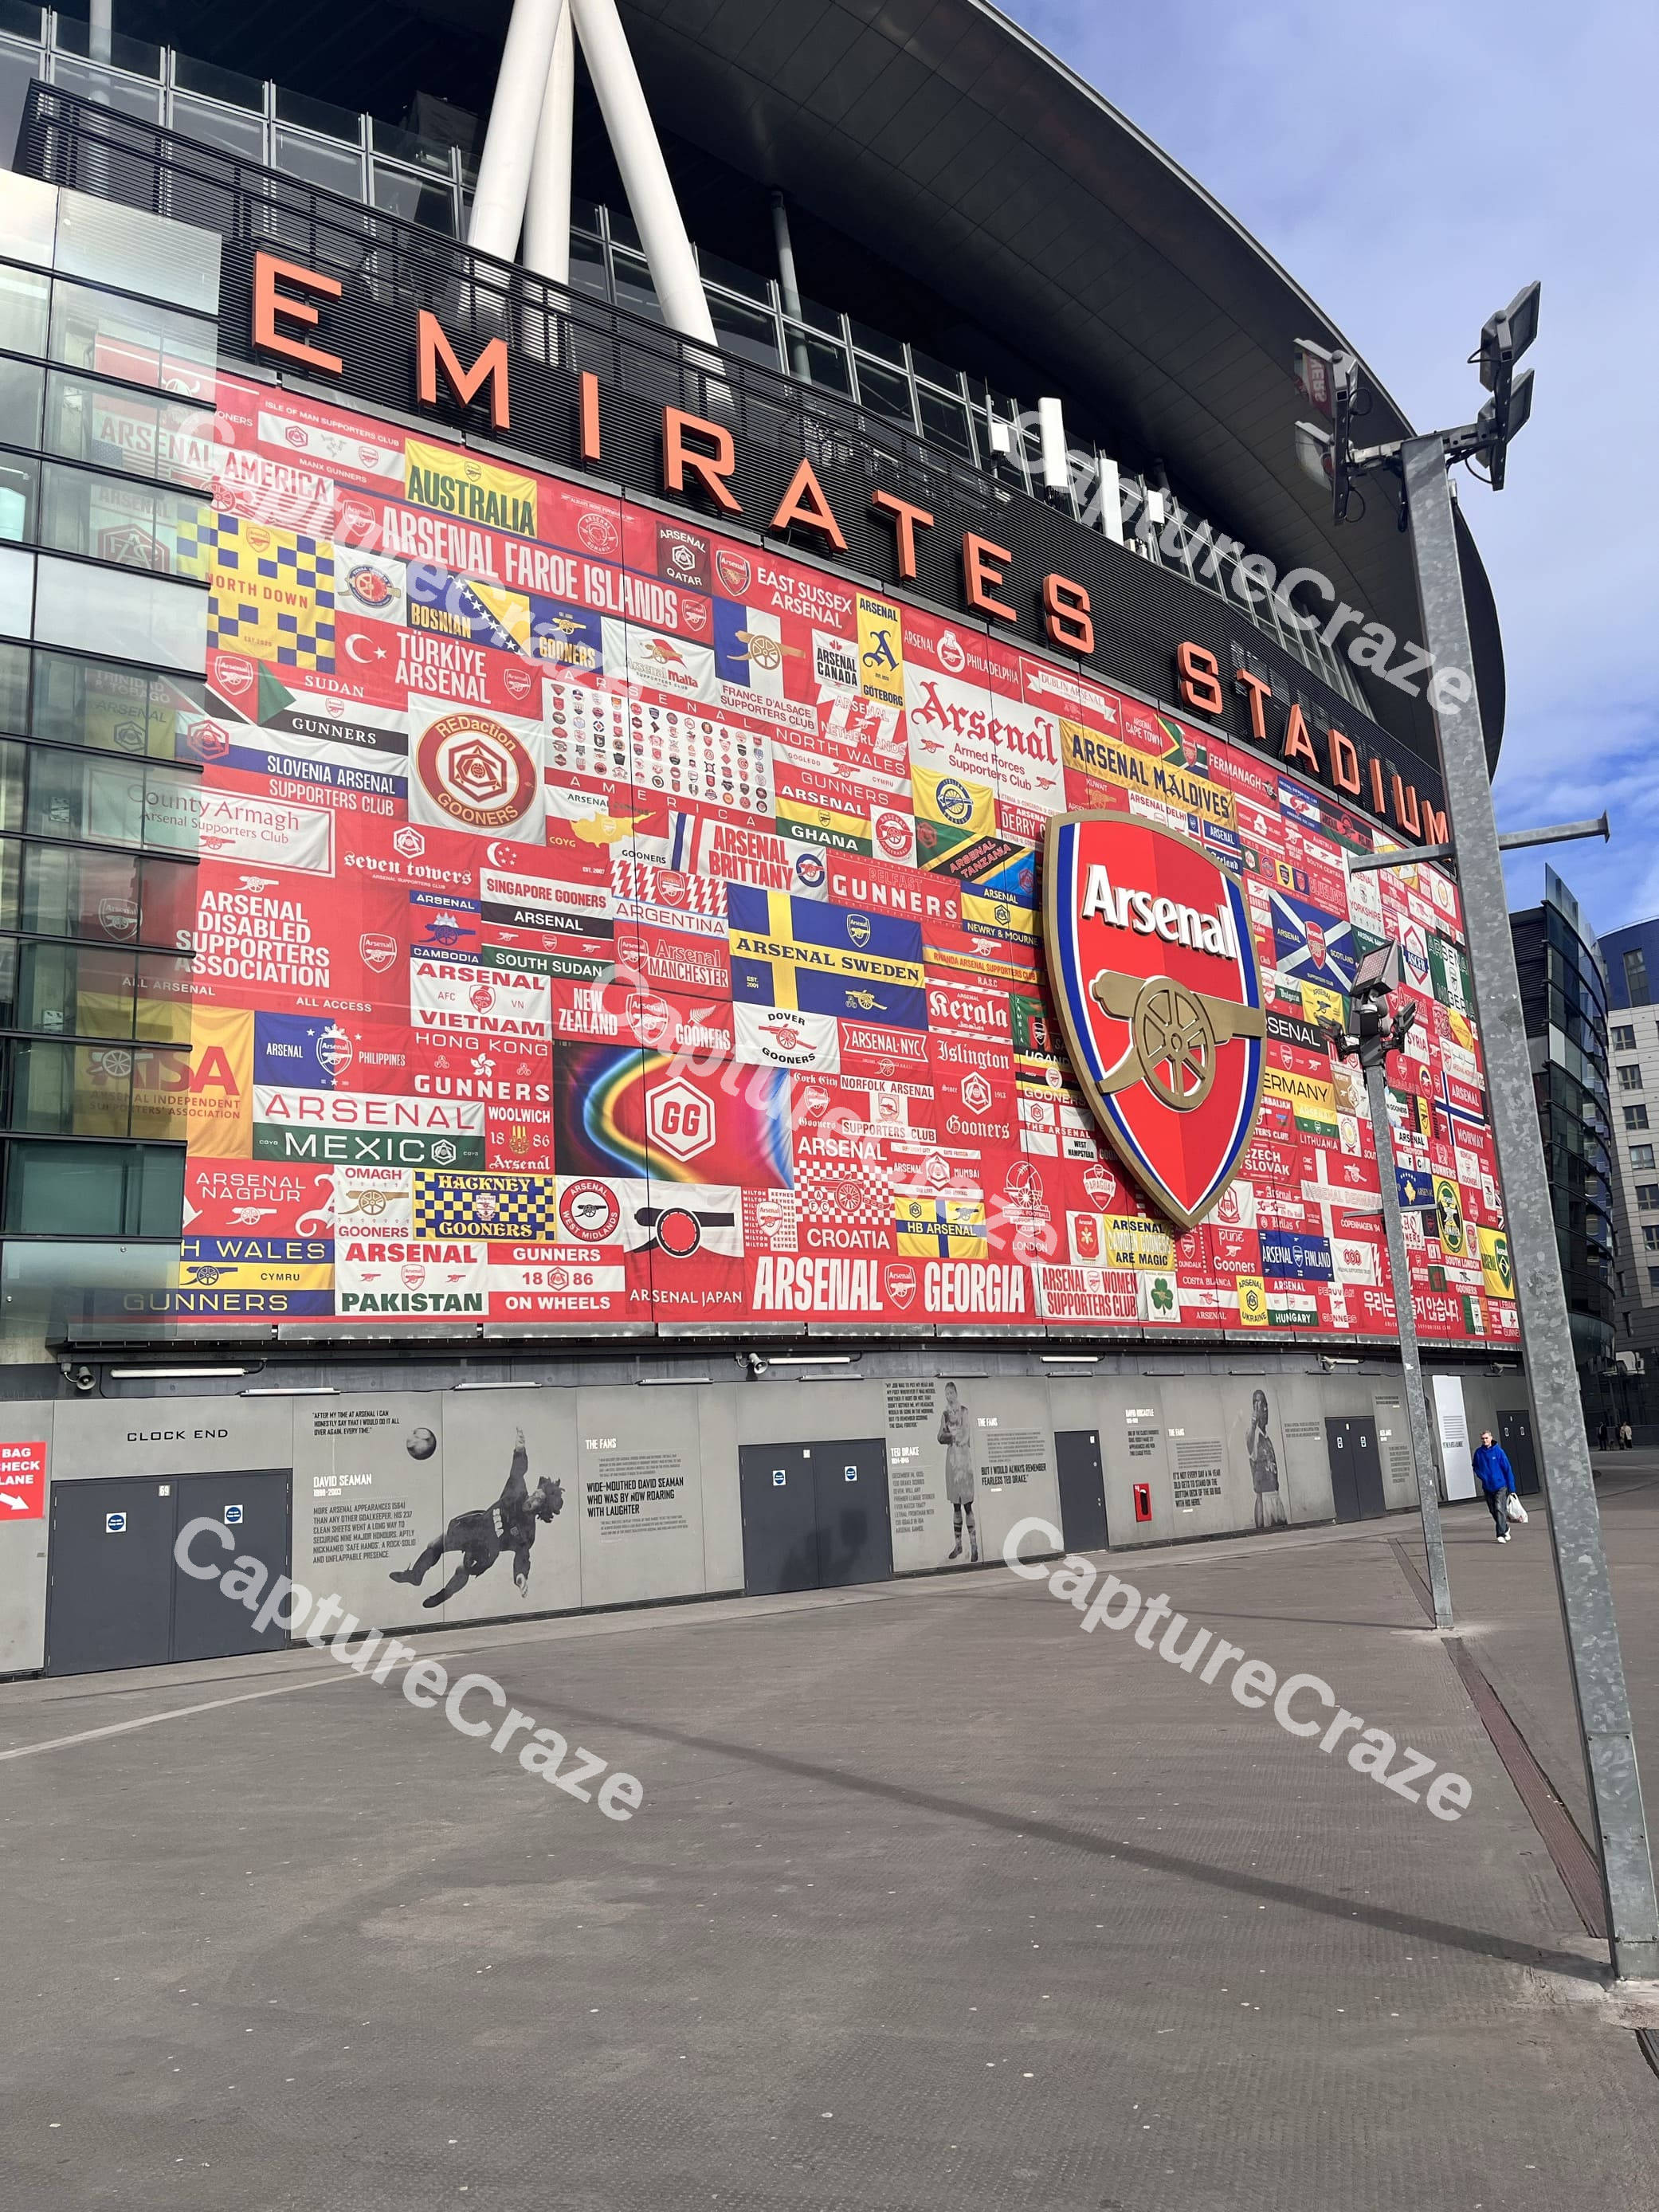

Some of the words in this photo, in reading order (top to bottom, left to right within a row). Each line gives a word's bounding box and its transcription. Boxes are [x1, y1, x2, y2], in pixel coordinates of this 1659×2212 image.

[265, 401, 284, 411] ISLE
[286, 406, 297, 415] OF
[300, 409, 319, 422] MAN
[320, 420, 372, 441] SUPPORTERS
[376, 433, 400, 447] CLUB
[252, 251, 1095, 655] EMIRATES
[299, 458, 324, 472] MANX
[326, 465, 367, 483] GUNNERS
[408, 465, 535, 536] AUSTRALIA
[660, 528, 706, 553] ARSENAL
[382, 506, 499, 577] ARSENAL
[505, 541, 578, 600] FAROE
[582, 563, 677, 629] ISLANDS
[666, 568, 702, 586] QATAR
[758, 567, 794, 594] EAST
[798, 583, 853, 615] SUSSEX
[410, 603, 472, 638] BOSNIAN
[771, 594, 842, 629] ARSENAL
[859, 598, 898, 622] ARSENAL
[539, 636, 596, 669] GOONERS
[904, 630, 935, 654] ARSENAL
[396, 631, 487, 678] TÜRKİYE
[817, 648, 856, 673] ARSENAL
[817, 661, 858, 687] CANADA
[967, 653, 1019, 684] PHILADELPHIA
[304, 675, 365, 698] SUDAN
[395, 660, 491, 704] ARSENAL
[863, 684, 904, 707] GÖTEBORG
[292, 717, 376, 744] GUNNERS
[911, 681, 1058, 766] Arsenal
[1125, 723, 1142, 738] CAPE
[1143, 729, 1163, 747] TOWN
[775, 728, 839, 756] NORTH
[846, 748, 907, 775] WALES
[1177, 641, 1453, 862] STADIUM
[267, 755, 332, 784] SLOVENIA
[337, 768, 395, 794] ARSENAL
[1210, 753, 1261, 790] FERMANAGH
[269, 779, 357, 811] SUPPORTERS
[362, 796, 394, 817] CLUB
[801, 771, 889, 805] GUNNERS
[781, 786, 866, 816] ARSENAL
[1130, 793, 1165, 813] ARSENAL
[1166, 807, 1186, 822] DELHI
[714, 826, 789, 865] ARSENAL
[790, 826, 859, 851] GHANA
[344, 852, 400, 874] seven
[406, 863, 473, 886] towers
[708, 851, 794, 891] BRITTANY
[201, 890, 308, 924] ARSENAL
[417, 894, 475, 909] ARSENAL
[833, 874, 958, 919] GUNNERS
[983, 888, 1018, 904] ARSENAL
[514, 911, 584, 932] ARSENAL
[617, 902, 725, 935] ARGENTINA
[1082, 864, 1237, 961] Arsenal
[198, 910, 312, 944] DISABLED
[967, 922, 996, 936] NEWRY
[1006, 931, 1038, 946] MOURNE
[175, 929, 331, 967] SUPPORTERS
[414, 947, 480, 963] CAMBODIA
[736, 938, 836, 967] ARSENAL
[841, 955, 920, 981] SWEDEN
[1330, 948, 1354, 964] SCOTLAND
[496, 952, 548, 971] SOUTH
[551, 960, 603, 977] SUDAN
[933, 952, 959, 965] RWANDA
[959, 958, 986, 971] ARSENAL
[987, 963, 1022, 979] SUPPORTERS
[1022, 970, 1036, 979] CLUB
[417, 963, 545, 991] ARSENAL
[438, 990, 456, 1002] AFC
[512, 1000, 524, 1010] VN
[573, 988, 603, 1013] NEW
[930, 991, 1009, 1029] Kerala
[420, 1010, 545, 1037] VIETNAM
[559, 1008, 618, 1037] ZEALAND
[415, 1033, 479, 1050] HONG
[489, 1040, 549, 1057] KONG
[676, 1023, 731, 1052] GOONERS
[1407, 1032, 1427, 1053] SYRIA
[266, 1043, 303, 1058] ARSENAL
[937, 1040, 1010, 1070] Islington
[414, 1074, 551, 1101] GUNNERS
[488, 1106, 551, 1124] WOOLWICH
[1300, 1135, 1338, 1151] LITHUANIA
[1457, 1128, 1484, 1148] NORWAY
[893, 1163, 923, 1175] ARSENAL
[954, 1168, 979, 1178] MUMBAI
[1245, 1160, 1290, 1175] SLOVAK
[437, 1175, 531, 1192] HACKNEY
[1084, 1179, 1116, 1194] PARAGUAY
[439, 1221, 533, 1237] GOONERS
[1340, 1219, 1372, 1230] COPENHAGEN
[216, 1240, 326, 1260] WALES
[806, 1229, 890, 1249] CROATIA
[1012, 1241, 1048, 1252] LONDON
[344, 1242, 478, 1263] ARSENAL
[512, 1247, 601, 1261] GUNNERS
[1116, 1252, 1135, 1263] ARE
[1138, 1253, 1168, 1265] MAGIC
[1262, 1245, 1293, 1265] ARSENAL
[1304, 1250, 1332, 1268] FINLAND
[1445, 1255, 1463, 1265] SOUTH
[1464, 1257, 1480, 1269] LONDON
[752, 1255, 884, 1311] ARSENAL
[924, 1261, 1026, 1313] GEORGIA
[1042, 1267, 1087, 1292] ARSENAL
[1101, 1271, 1138, 1294] WOMEN
[1182, 1277, 1204, 1285] COSTA
[1206, 1277, 1231, 1287] BLANCA
[342, 1292, 483, 1312] PAKISTAN
[505, 1296, 527, 1309] ON
[540, 1296, 610, 1310] WHEELS
[1363, 1291, 1395, 1318] 우리는
[1242, 1313, 1267, 1322] UKRAINE
[1275, 1313, 1311, 1324] HUNGARY
[127, 1431, 186, 1442] CLOCK
[194, 1429, 229, 1439] END
[2, 1448, 32, 1458] BAG
[891, 1448, 903, 1457] TED
[904, 1447, 919, 1457] DRAKE
[0, 1460, 41, 1471] HECK
[981, 1466, 990, 1475] BUT
[994, 1465, 1008, 1474] WOULD
[1009, 1464, 1025, 1473] ALWAYS
[1026, 1463, 1046, 1473] REMEMBER
[0, 1473, 34, 1485] LANE
[159, 1485, 170, 1496] 69
[313, 1477, 336, 1488] DAVID
[339, 1474, 372, 1486] SEAMAN
[586, 1481, 636, 1492] WIDE-MOUTHED
[638, 1479, 657, 1489] DAVID
[657, 1477, 684, 1488] SEAMAN
[982, 1476, 1003, 1485] FEARLESS
[587, 1495, 602, 1504] WHO
[604, 1494, 618, 1504] WAS
[620, 1493, 629, 1503] BY
[630, 1492, 645, 1501] NOW
[646, 1489, 674, 1501] ROARING
[587, 1508, 605, 1517] WITH
[606, 1504, 640, 1516] LAUGHTER
